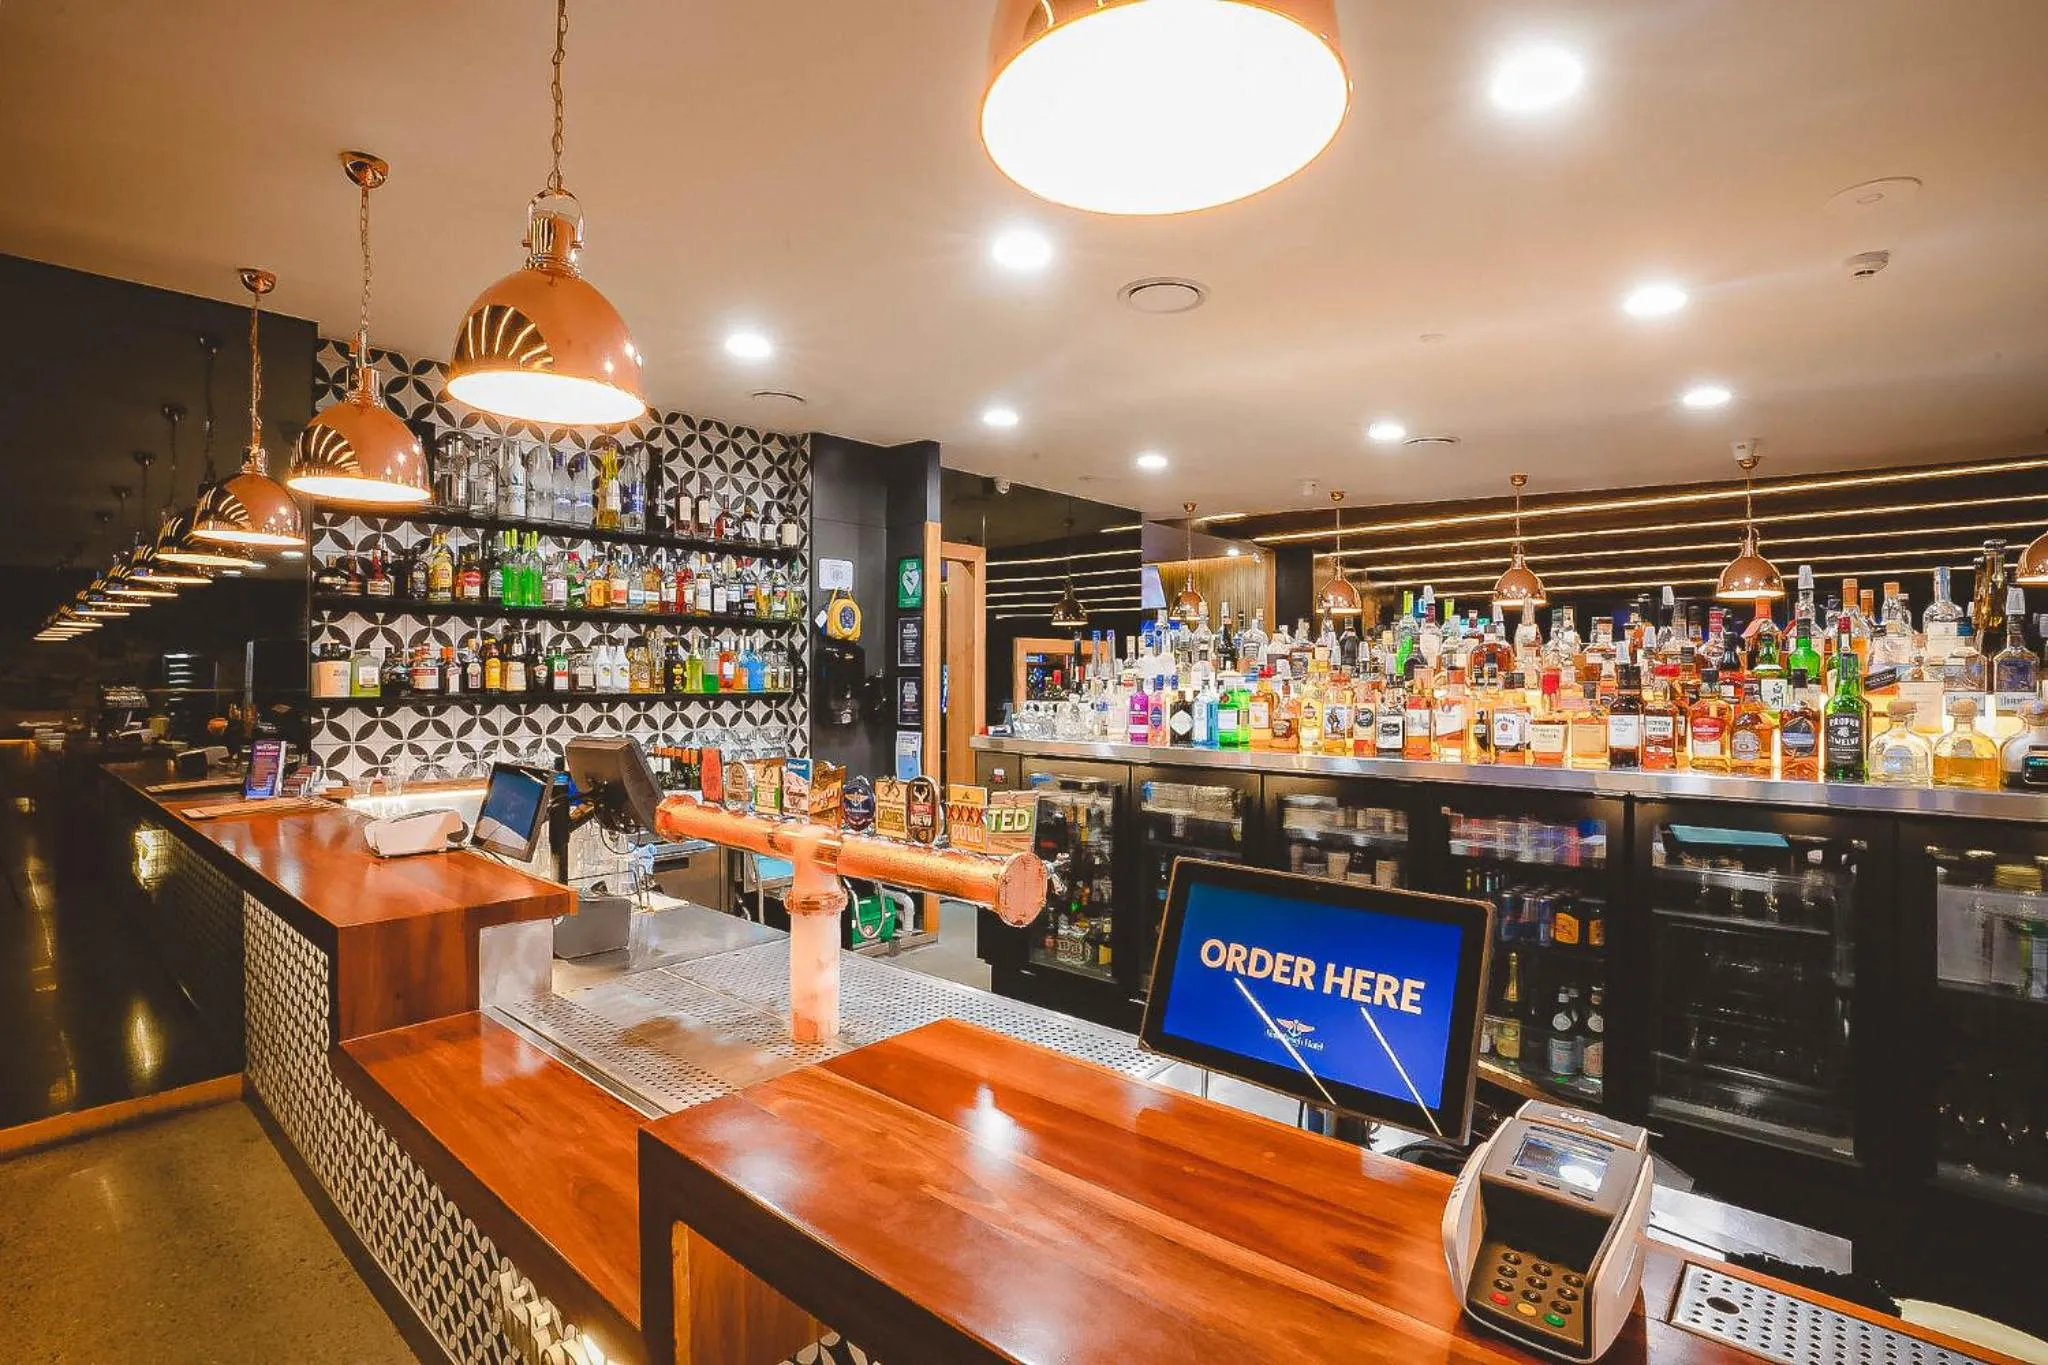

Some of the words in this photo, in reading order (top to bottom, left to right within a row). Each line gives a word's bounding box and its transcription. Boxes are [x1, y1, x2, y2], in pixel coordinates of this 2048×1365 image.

[910, 813, 932, 827] NEW
[988, 808, 1030, 832] TED
[951, 823, 983, 843] GOLD
[1200, 938, 1316, 991] ORDER
[1322, 962, 1426, 1015] HERE
